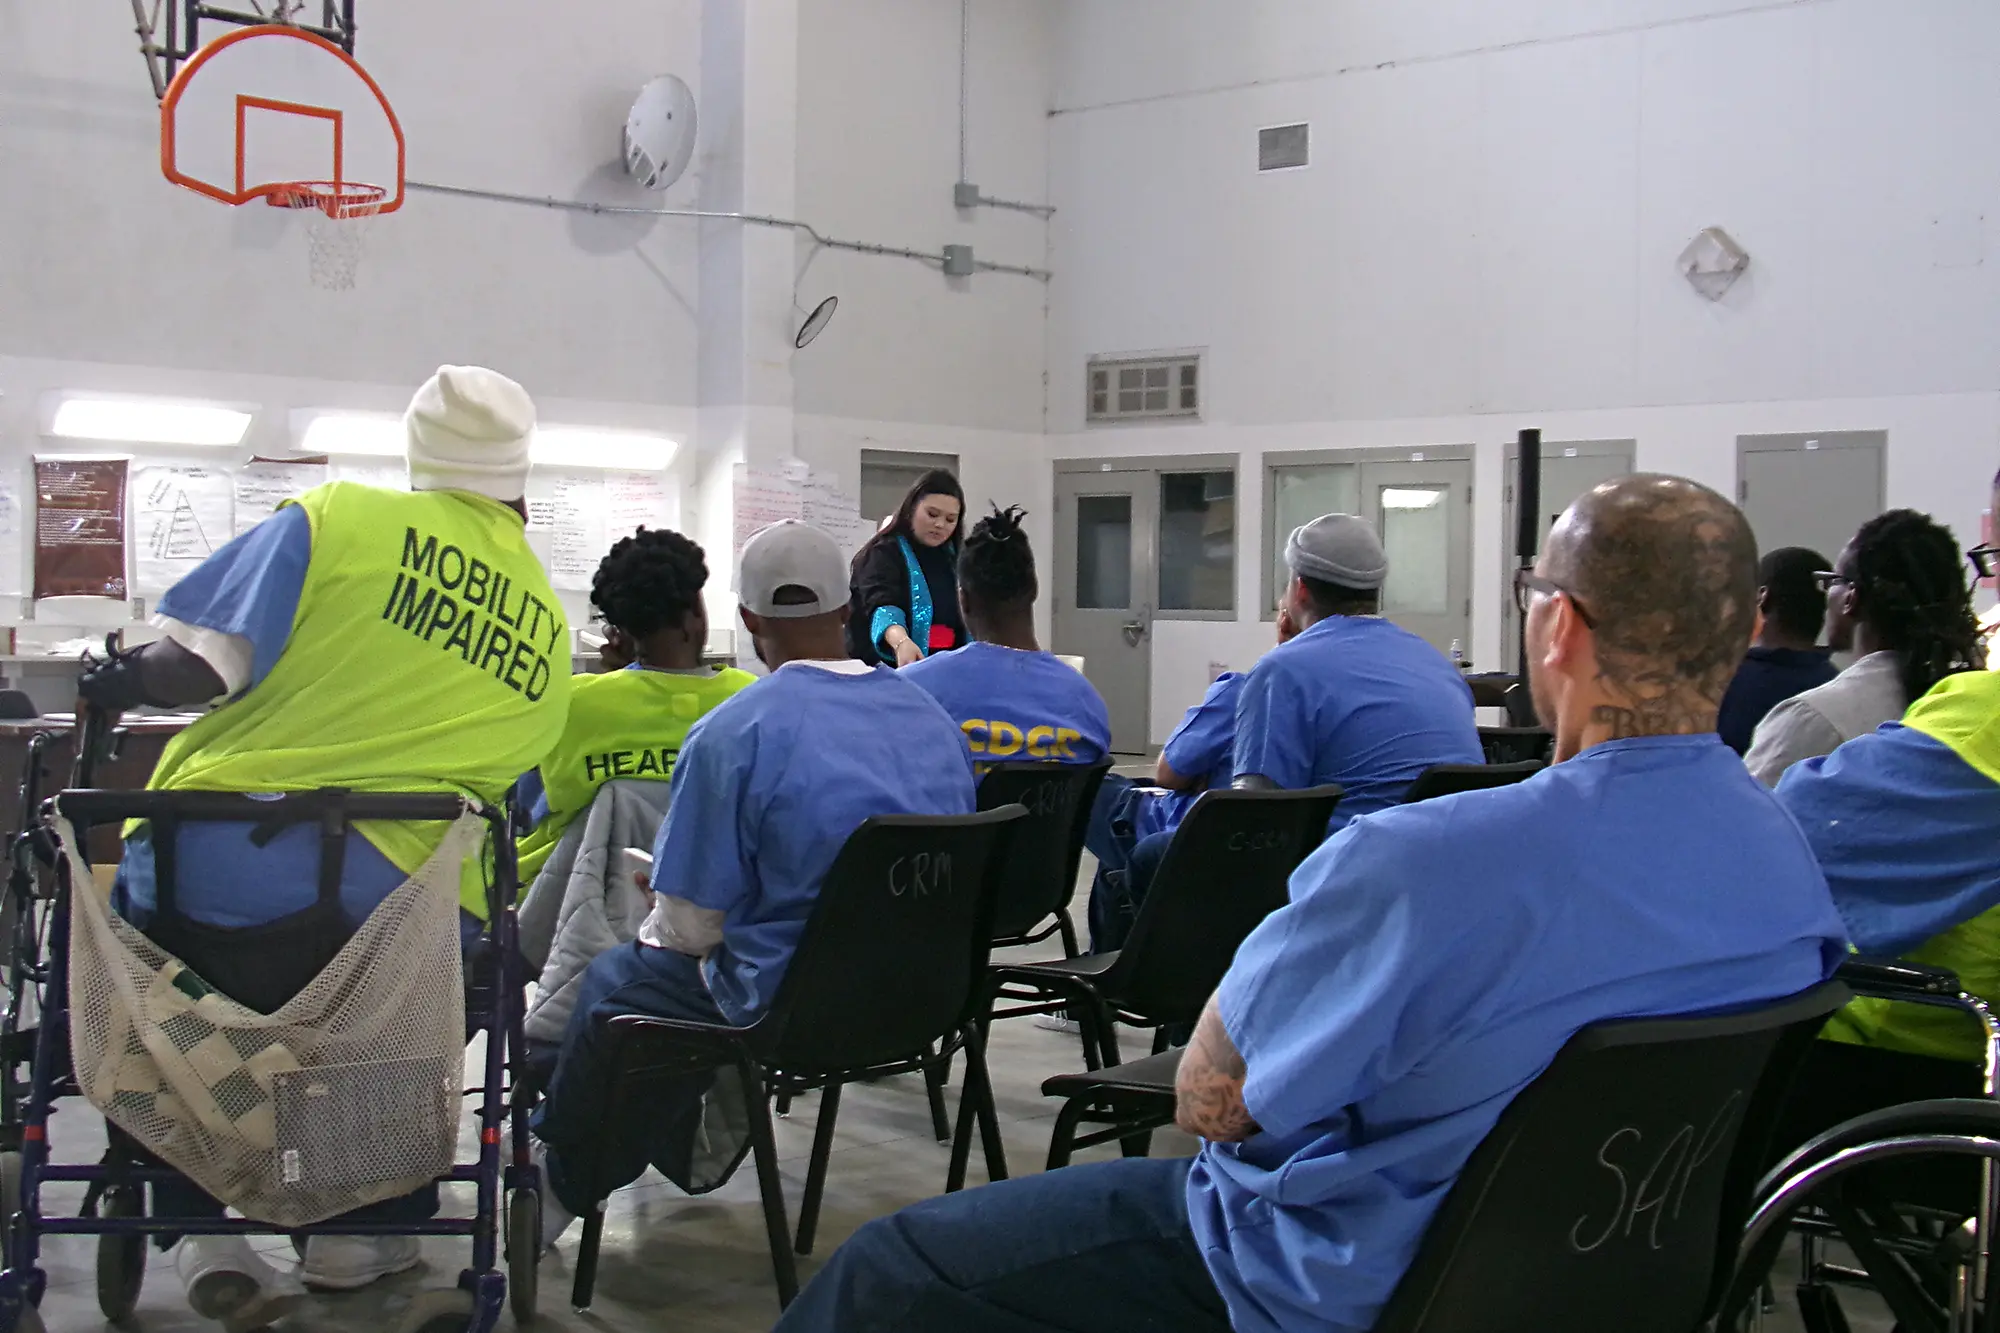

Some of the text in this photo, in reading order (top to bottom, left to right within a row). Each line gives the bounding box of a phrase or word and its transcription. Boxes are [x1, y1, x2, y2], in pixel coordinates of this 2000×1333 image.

[382, 572, 550, 702] IMPAIRED
[400, 526, 563, 655] MOBILITY
[888, 851, 952, 900] CRM
